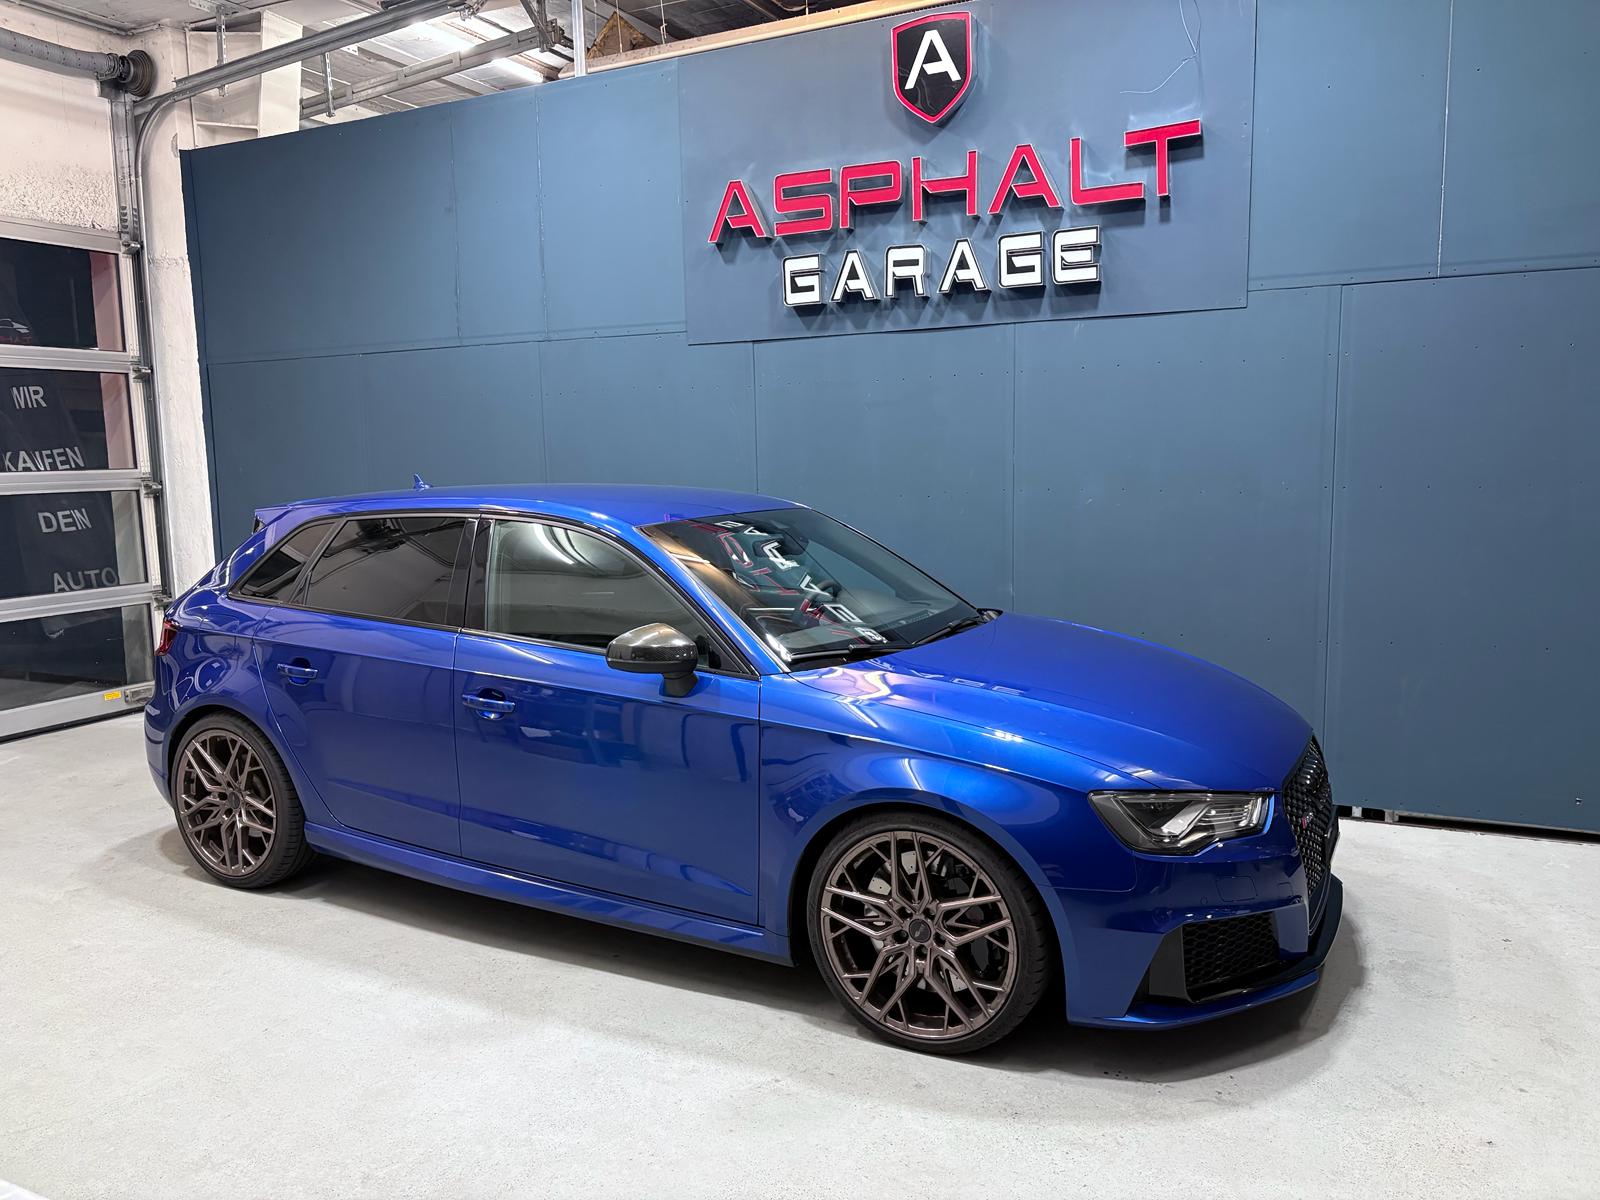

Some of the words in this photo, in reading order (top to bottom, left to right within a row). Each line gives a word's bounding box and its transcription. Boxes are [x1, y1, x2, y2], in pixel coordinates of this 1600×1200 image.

[904, 30, 962, 90] A
[708, 119, 1202, 243] ASPHALT
[783, 225, 1101, 306] GARAGE
[37, 507, 92, 533] DEIN
[53, 567, 118, 593] AUTO
